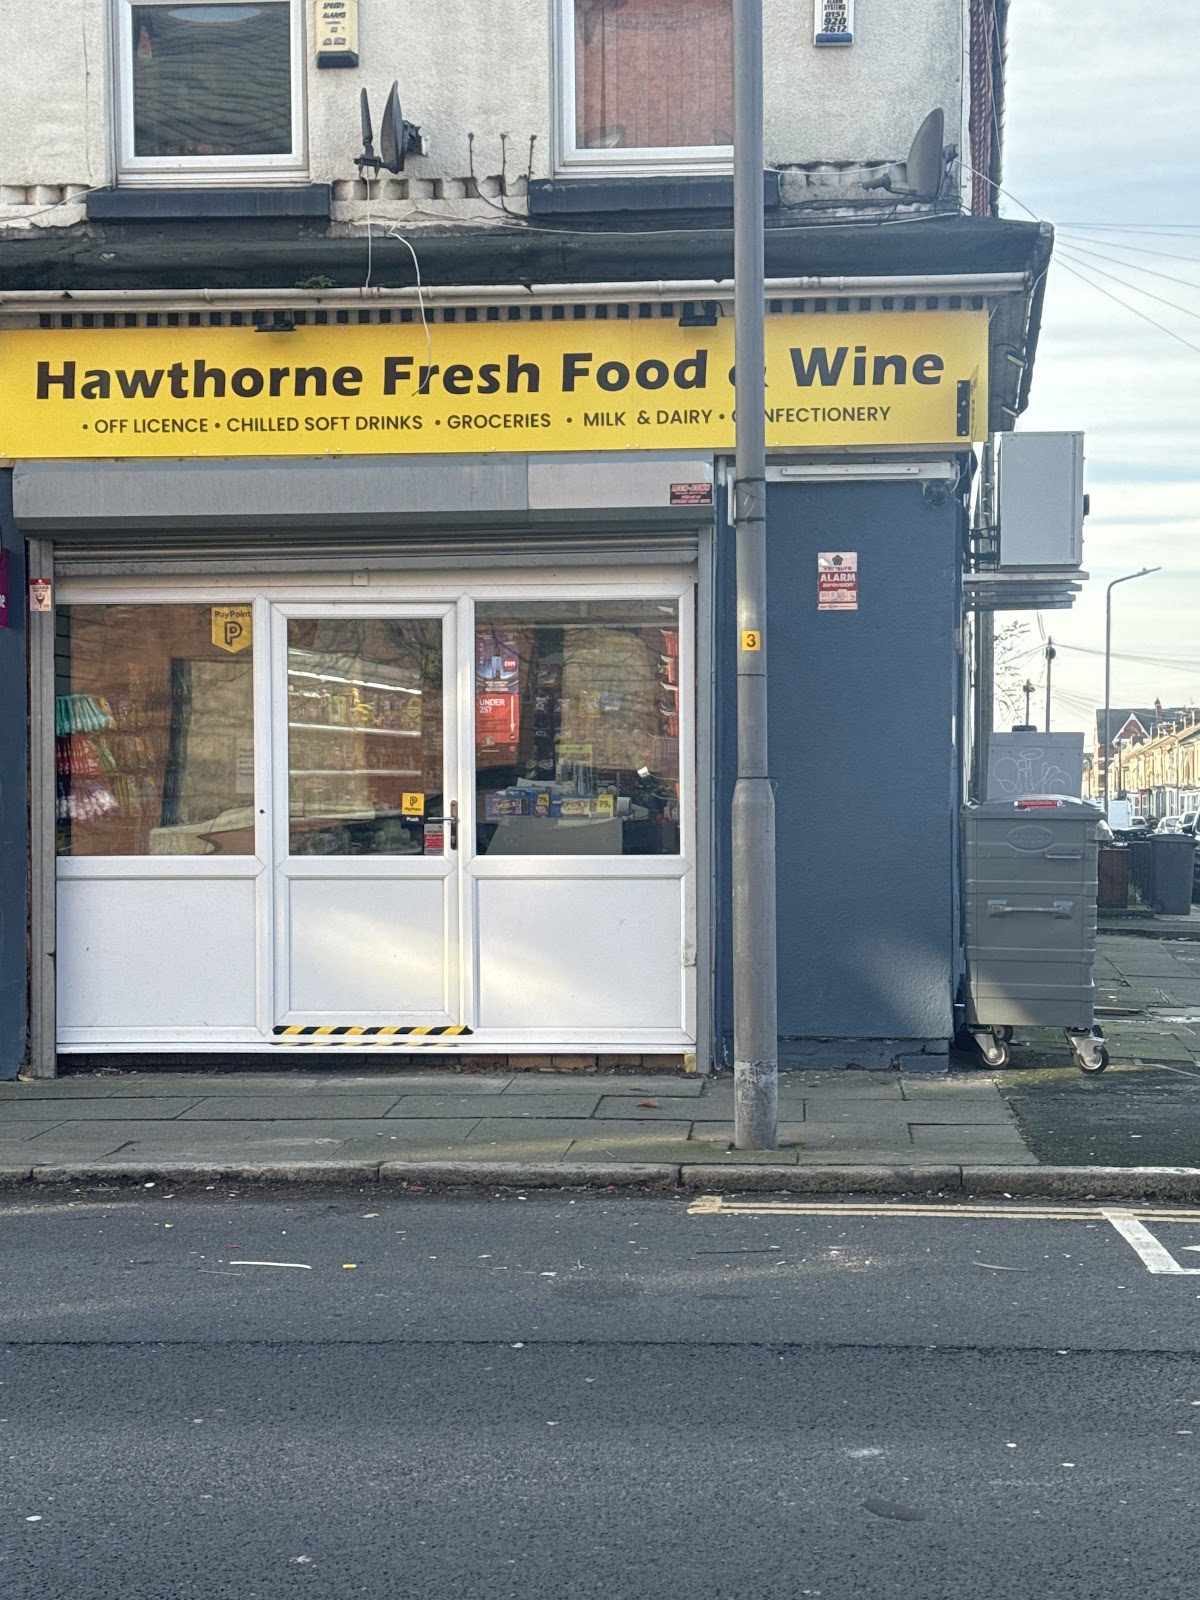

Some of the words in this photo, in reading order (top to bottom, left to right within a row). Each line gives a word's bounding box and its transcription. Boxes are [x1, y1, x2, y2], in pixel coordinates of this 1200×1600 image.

[824, 17, 847, 25] 920
[822, 25, 847, 33] 4612
[37, 360, 363, 400] Hawthorne
[384, 355, 540, 396] Fresh
[562, 350, 707, 393] Food
[789, 346, 944, 387] Wine
[95, 419, 129, 434] OFF
[134, 418, 208, 434] LICENCE
[227, 417, 300, 432] CHILLED
[305, 416, 351, 432] SOFT
[356, 415, 423, 431] DRINKS
[448, 413, 551, 430] GROCERIES
[584, 412, 626, 427] MILK
[637, 411, 650, 425] &
[657, 409, 713, 425] DAIRY
[732, 406, 891, 423] NFECTIONERY
[820, 573, 856, 582] ALARM
[214, 610, 252, 619] PayPoint
[746, 633, 756, 648] 3
